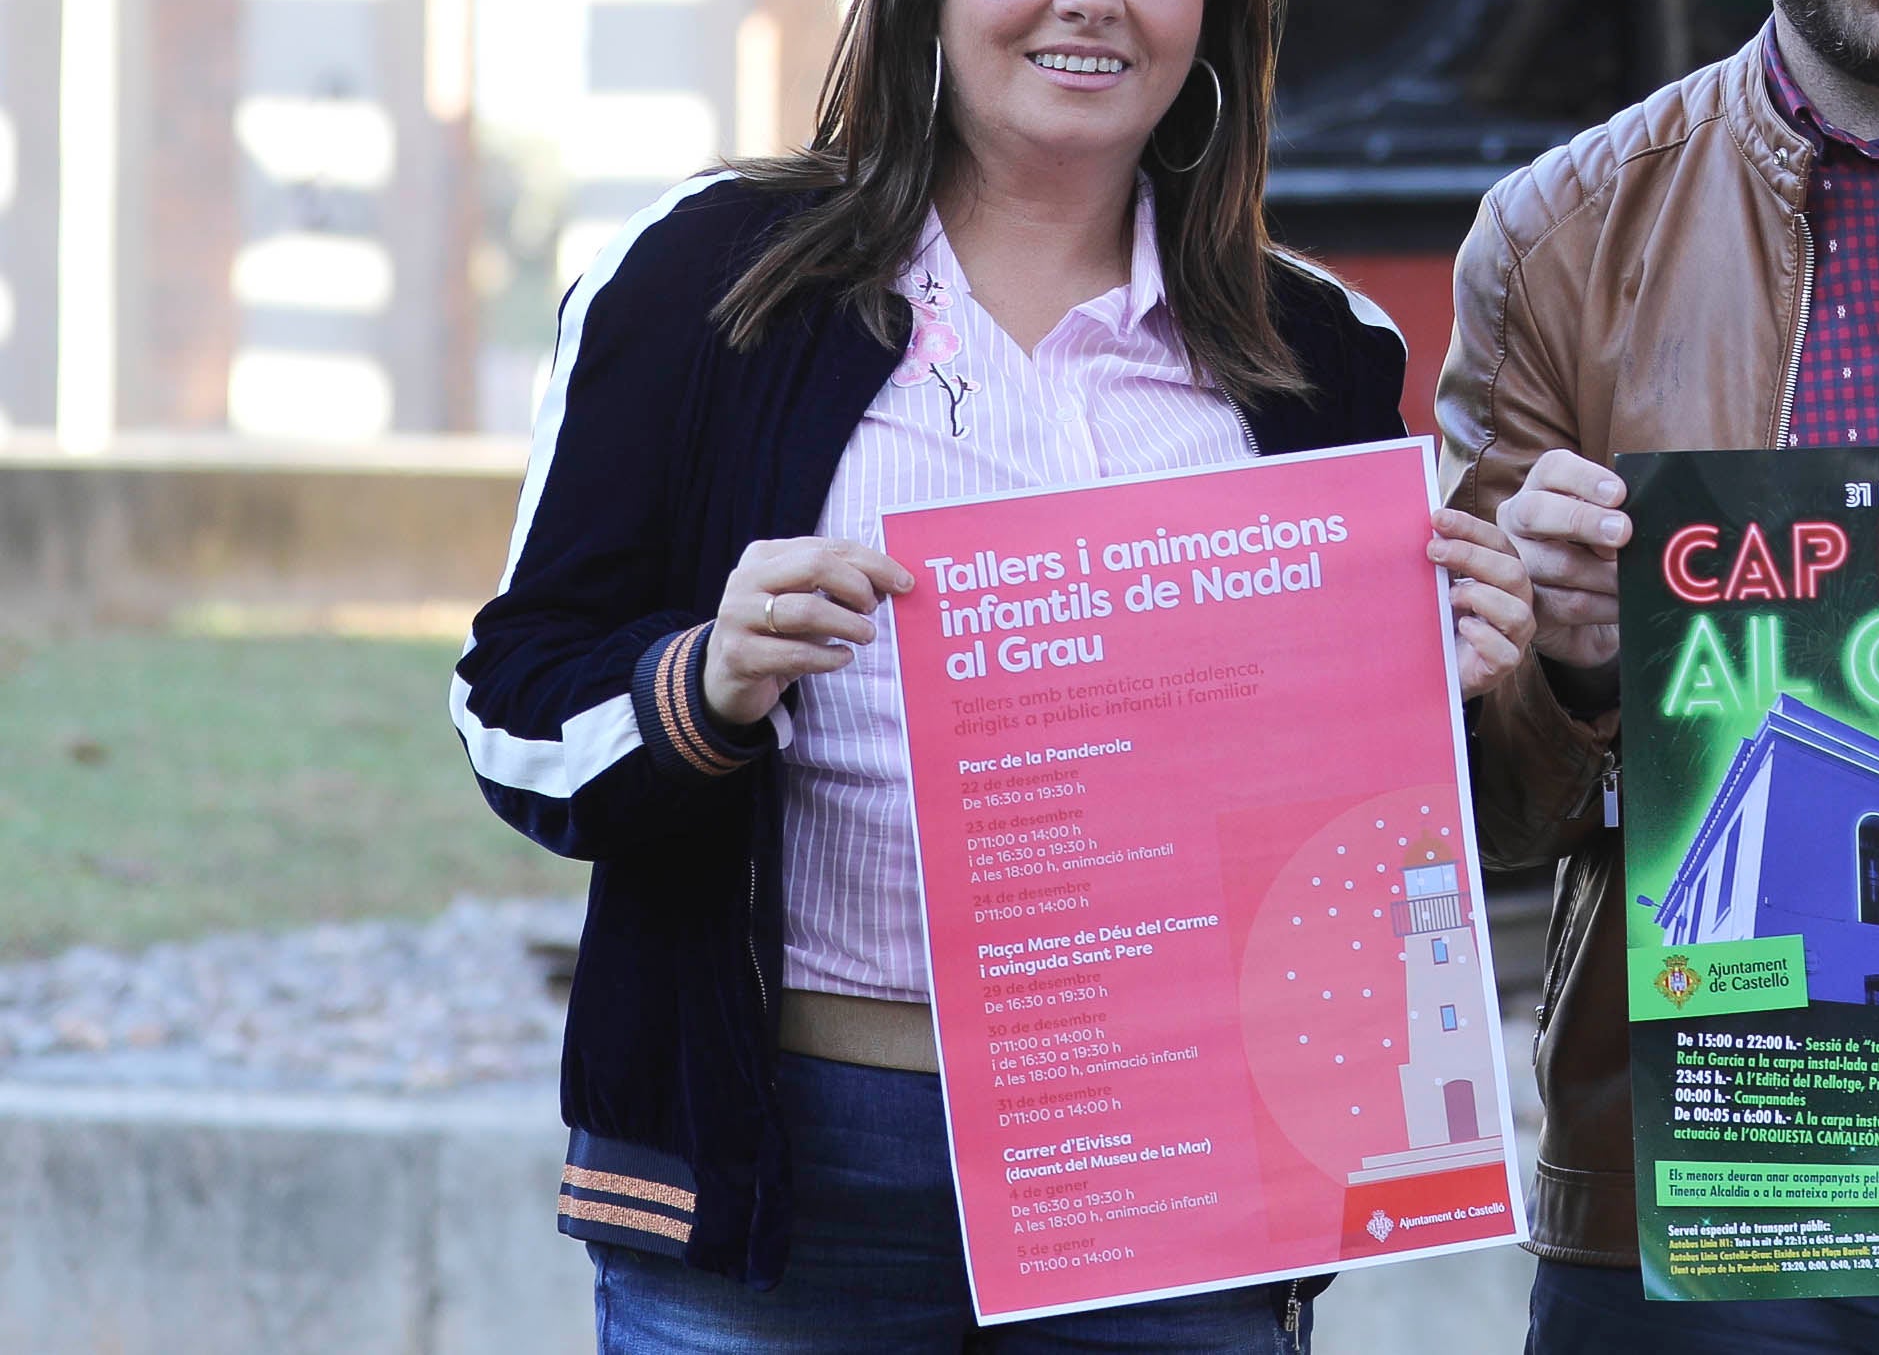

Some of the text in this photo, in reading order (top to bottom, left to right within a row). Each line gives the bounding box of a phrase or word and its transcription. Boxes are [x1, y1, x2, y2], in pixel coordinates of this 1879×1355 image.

[1843, 481, 1873, 509] 31
[923, 513, 1348, 595] Tallers i animacions
[1663, 521, 1848, 604] CAP
[938, 550, 1323, 639] infantils de Nadal
[945, 633, 1105, 682] al Grau
[1664, 613, 1812, 716] AL
[950, 695, 1015, 718] Tallers
[1017, 686, 1063, 708] amb
[953, 681, 1260, 738] dirigits a públic infantil i familiar
[958, 737, 1133, 776] Parc de la Panderola
[961, 780, 1087, 811] De 16:30 a 19:30 h
[969, 841, 1175, 885] A les 18:00 h, animació infantil
[977, 914, 1220, 960] Plaça Mare de Déu del Carme
[978, 942, 1154, 980] i avinguda Sant Pere
[1706, 957, 1789, 979] Ajuntament
[1708, 971, 1791, 994] de Castelló
[1676, 1031, 1695, 1048] De
[1697, 1031, 1734, 1049] 15:00
[1734, 1037, 1745, 1050] a
[1745, 1034, 1784, 1051] 22:00
[1804, 1036, 1843, 1053] Sessió
[1844, 1037, 1861, 1054] de
[1675, 1049, 1706, 1067] Rafa
[1747, 1056, 1757, 1068] a
[1757, 1053, 1771, 1069] la
[1771, 1057, 1806, 1073] carpa
[1675, 1069, 1713, 1086] 23:45
[1733, 1071, 1746, 1087] A
[1791, 1073, 1812, 1089] del
[1812, 1073, 1866, 1094] Rellotge,
[1673, 1086, 1713, 1105] 00:00
[1733, 1089, 1808, 1108] Campanades
[1673, 1106, 1692, 1122] De
[1692, 1107, 1731, 1124] 00:05
[1731, 1111, 1742, 1124] a
[1741, 1108, 1773, 1125] 6:00
[1793, 1110, 1805, 1126] A
[1805, 1110, 1819, 1127] la
[1820, 1115, 1854, 1130] carpa
[1672, 1127, 1722, 1142] actuació
[1722, 1127, 1739, 1142] de
[1002, 1143, 1058, 1163] Carrer
[1004, 1136, 1213, 1186] (davant del Museu de la Mar)
[1667, 1183, 1708, 1198] Tinença
[1752, 1188, 1761, 1199] o
[1761, 1188, 1771, 1199] a
[1771, 1185, 1783, 1199] la
[1784, 1185, 1829, 1200] mateixa
[1830, 1187, 1860, 1202] porta
[1861, 1185, 1879, 1200] del
[1398, 1201, 1506, 1231] Ajuntament de Castelló
[1738, 1222, 1753, 1236] de
